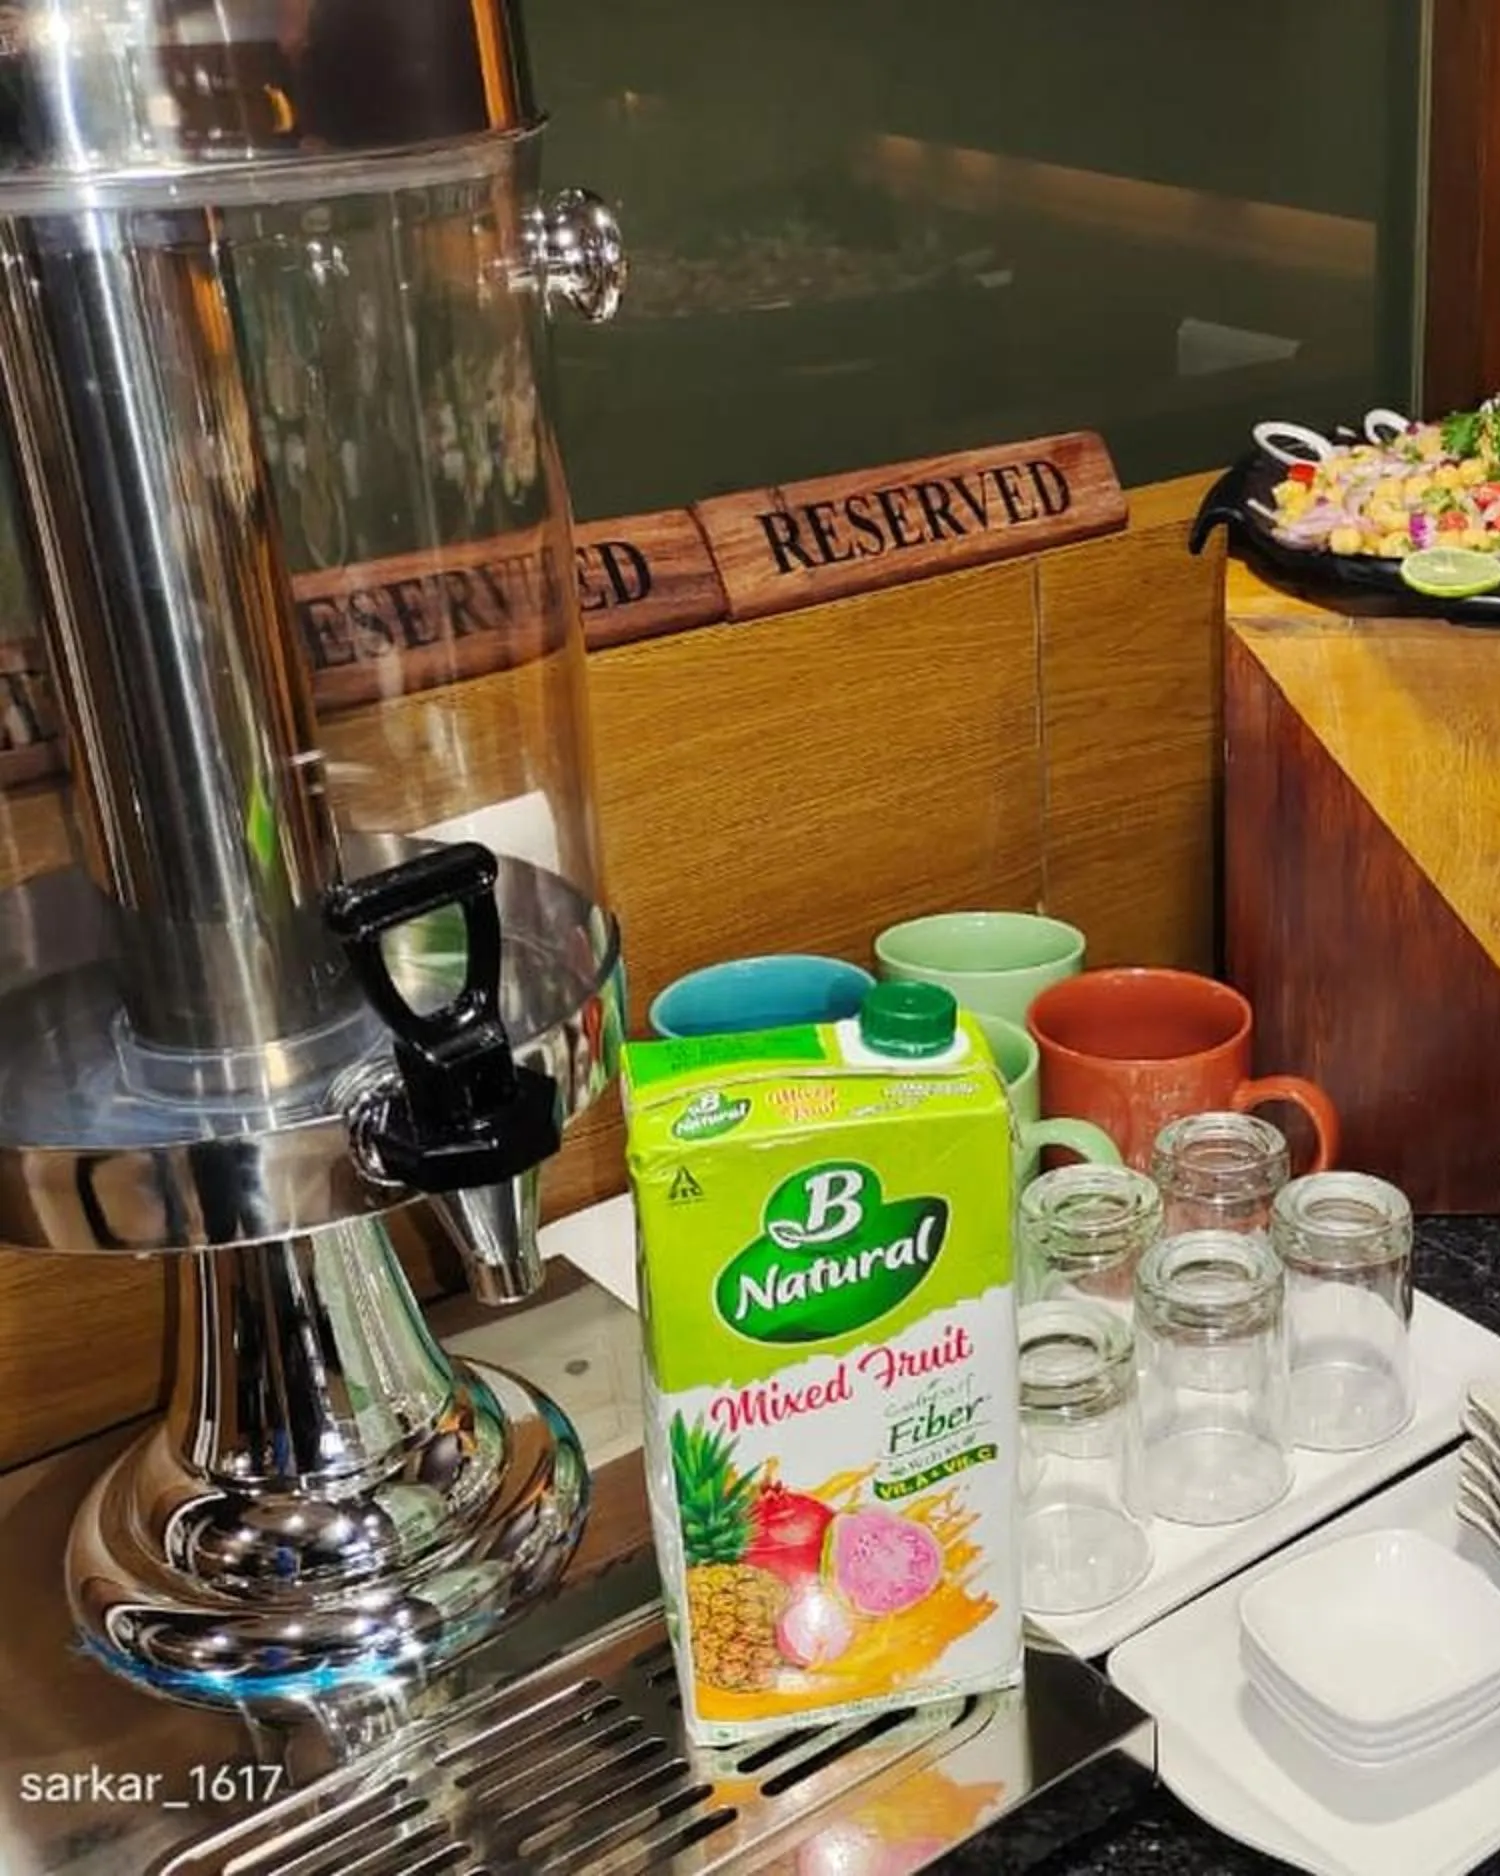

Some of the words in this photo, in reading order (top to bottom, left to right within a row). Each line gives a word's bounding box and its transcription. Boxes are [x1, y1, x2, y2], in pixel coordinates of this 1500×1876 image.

[756, 461, 1072, 575] RESERVED
[778, 1169, 864, 1245] B
[735, 1216, 936, 1321] Natural
[710, 1363, 854, 1434] Mixed
[857, 1325, 975, 1390] Fruit
[885, 1395, 986, 1453] Fiber
